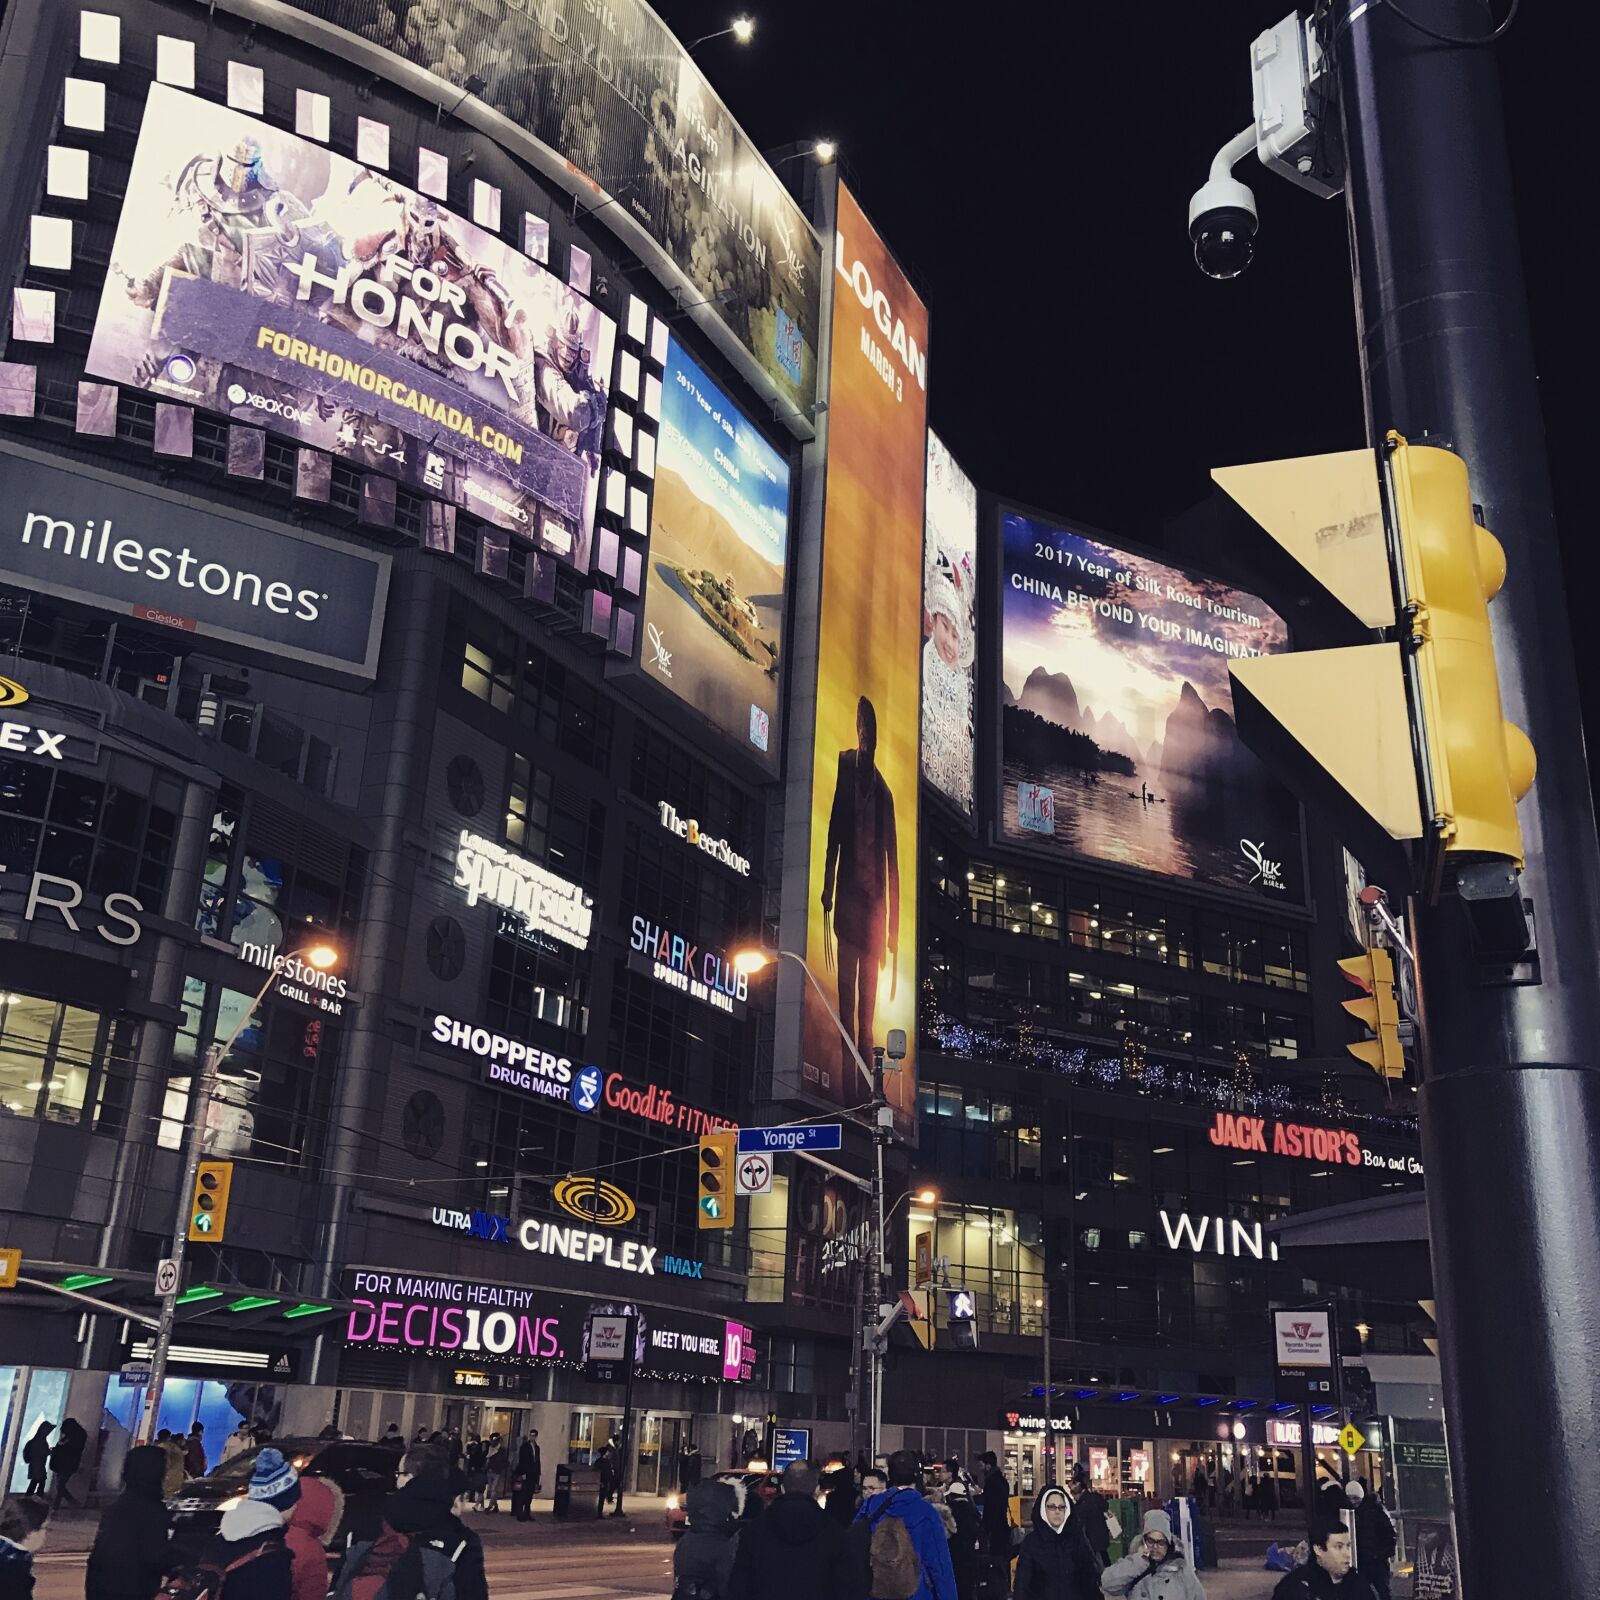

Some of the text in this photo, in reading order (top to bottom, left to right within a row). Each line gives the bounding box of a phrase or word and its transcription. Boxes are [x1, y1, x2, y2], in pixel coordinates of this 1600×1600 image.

[383, 254, 467, 319] FOR
[835, 230, 925, 392] LOGAN
[282, 252, 520, 404] HONOR
[860, 326, 903, 403] MARCH 3
[246, 391, 314, 426] XBOX ONE
[256, 326, 523, 466] FORHONORCANADA.COM
[676, 370, 695, 396] 2017
[695, 389, 712, 414] Year
[712, 411, 722, 424] of
[361, 434, 405, 464] PS4
[714, 447, 740, 484] CHINA
[21, 511, 321, 622] milestones
[1034, 542, 1261, 628] 2017 Year of Silk Road Tourism
[146, 609, 185, 628] Cieslok
[1011, 573, 1270, 660] CHINA BEYOND YOUR IMAGINAT
[0, 864, 144, 946] RS
[241, 939, 347, 999] milestones
[630, 915, 698, 978] SHARK
[703, 952, 748, 1002] CLUB
[279, 983, 310, 1005] GRILL
[320, 998, 342, 1016] BAR
[653, 962, 735, 1013] SPORTS BAR GRILL
[432, 1014, 572, 1084] SHOPPERS
[489, 1063, 570, 1101] DRUG MART
[763, 1128, 816, 1149] Yonge St
[1210, 1112, 1268, 1153] JACK
[1273, 1122, 1361, 1166] ASTOR'S
[1361, 1149, 1386, 1168] Bar
[1388, 1156, 1405, 1171] and
[432, 1206, 472, 1230] ULTRA
[1160, 1210, 1278, 1261] WIN
[519, 1219, 703, 1280] CINEPLEX IMAX
[354, 1273, 533, 1309] FOR MAKING HEALTHY
[652, 1330, 720, 1356] MEET YOU HERE.
[726, 1333, 741, 1367] 10
[465, 1374, 490, 1386] Dundas
[1281, 1369, 1305, 1377] Dundas
[1018, 1416, 1046, 1429] wine
